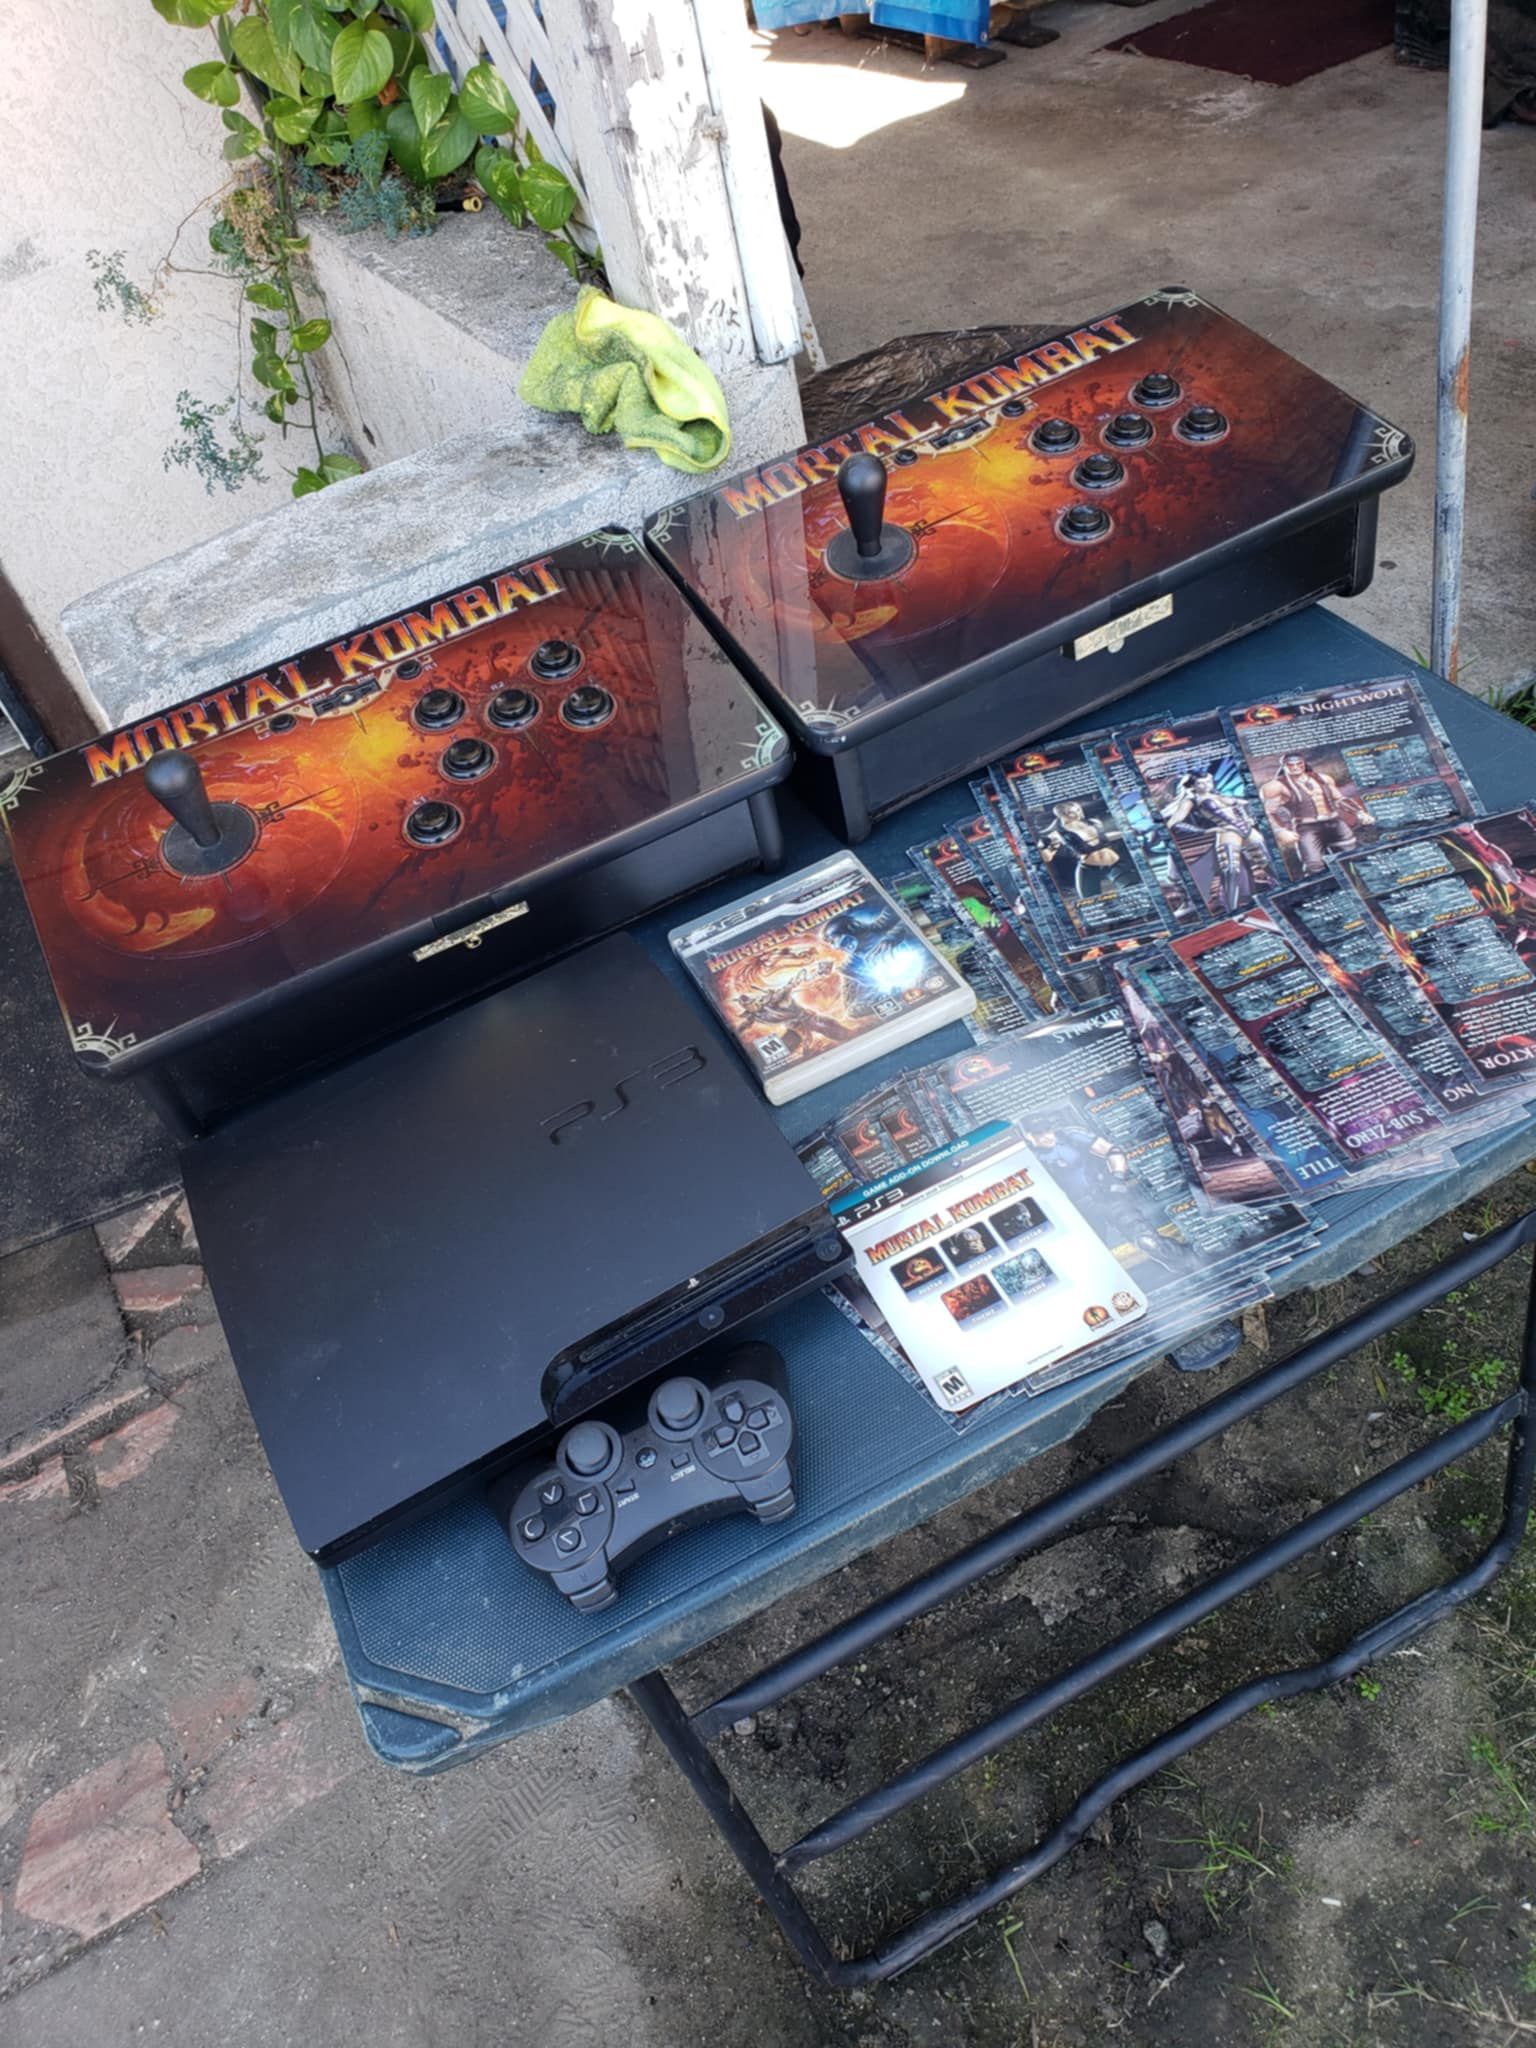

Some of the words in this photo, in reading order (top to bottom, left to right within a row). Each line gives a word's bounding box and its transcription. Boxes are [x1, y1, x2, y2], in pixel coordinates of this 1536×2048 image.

[719, 409, 942, 520] MORTAL
[923, 314, 1142, 423] KOMBAT
[84, 660, 333, 787] MORTAL
[326, 556, 567, 681] KOMBAT
[706, 928, 789, 975] MORTAL
[787, 892, 865, 936] KOMBAT
[761, 1039, 782, 1056] M
[538, 1045, 707, 1145] PS3
[1346, 1114, 1424, 1148] SUB-ZERO
[854, 1187, 905, 1219] PS3
[862, 1183, 888, 1198] GAME
[888, 1165, 921, 1185] ADD-ON
[921, 1140, 969, 1168] DOWNLOAD
[864, 1212, 952, 1266] MORTAL
[946, 1168, 1035, 1223] KOMBAT
[941, 1375, 963, 1396] M
